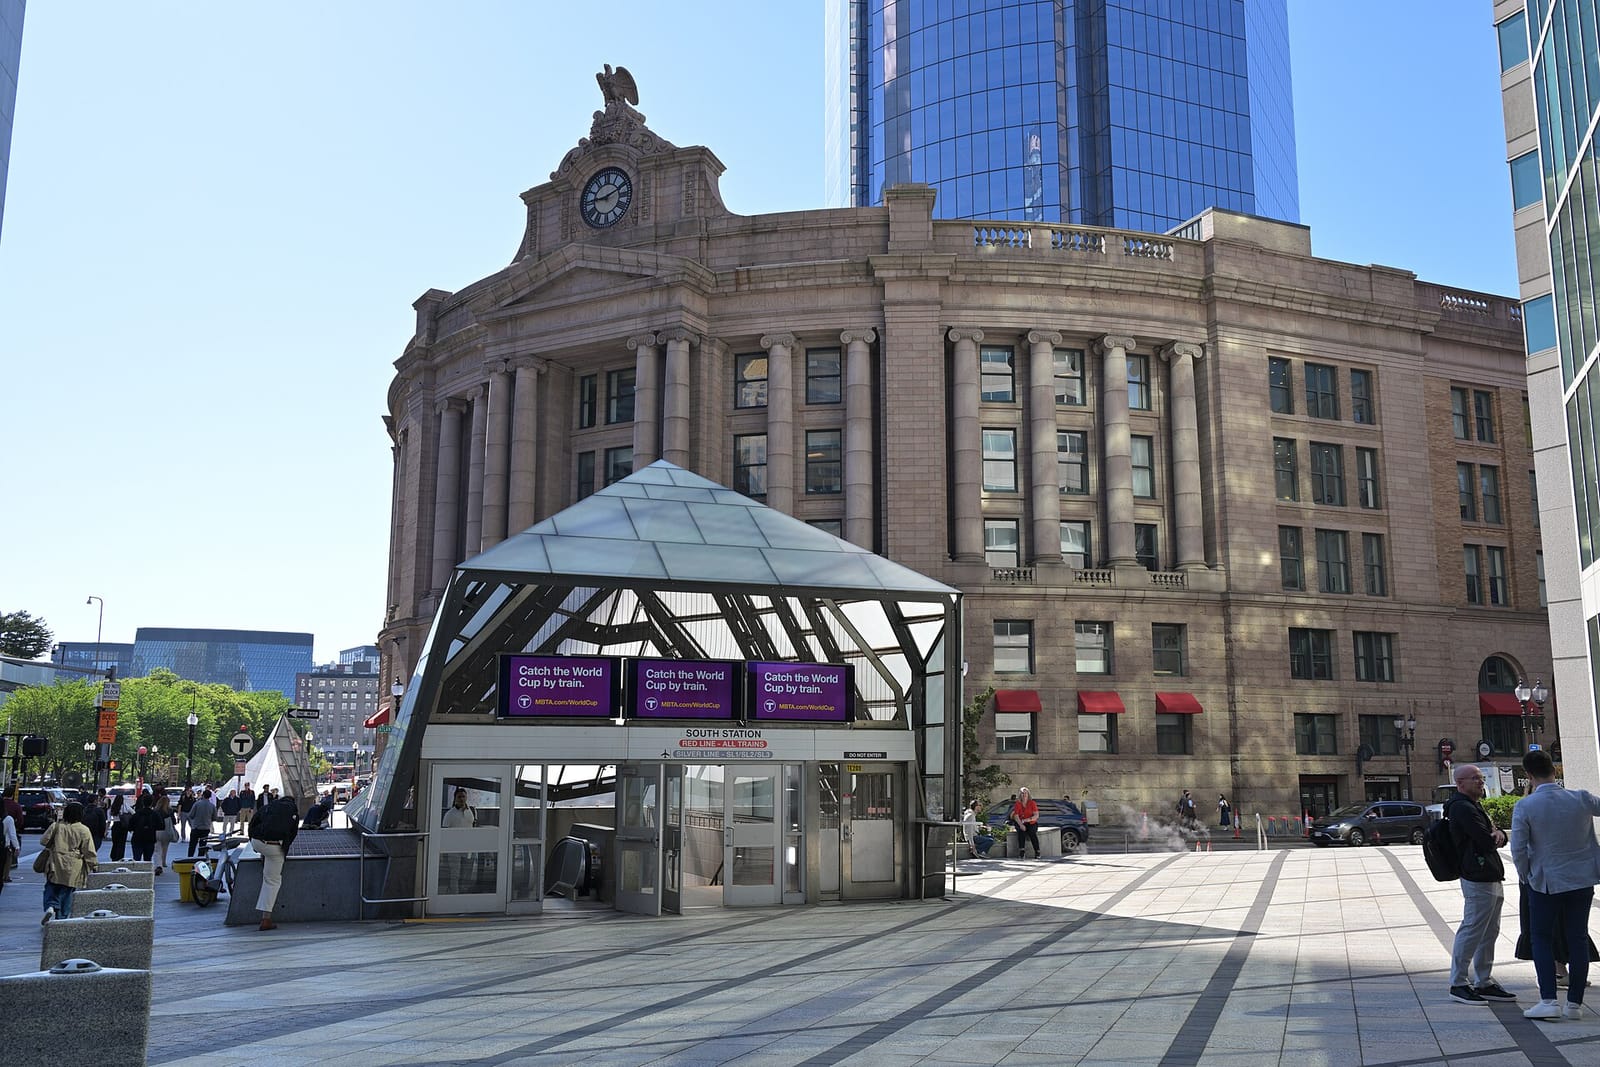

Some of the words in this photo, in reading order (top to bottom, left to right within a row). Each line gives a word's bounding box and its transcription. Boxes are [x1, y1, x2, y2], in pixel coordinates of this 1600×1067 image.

[519, 665, 551, 676] Catch
[553, 666, 570, 676] the
[572, 667, 603, 677] World
[646, 669, 676, 679] Catch
[678, 670, 694, 680] the
[696, 670, 725, 680] World
[518, 677, 541, 689] Cup
[543, 678, 556, 689] by
[558, 678, 585, 688] train.
[764, 672, 793, 682] Catch
[794, 673, 810, 683] the
[811, 674, 839, 684] World
[645, 680, 667, 692] Cup
[668, 681, 681, 692] by
[683, 681, 708, 691] train.
[764, 683, 784, 694] Cup
[786, 684, 798, 695] by
[799, 684, 823, 694] train.
[534, 698, 598, 707] MBTA.com/WorldCup
[661, 701, 721, 709] MBTA.com/WorldCup
[778, 703, 835, 711] MBTA.com/WorldCup
[686, 729, 720, 738] SOUTH
[722, 729, 762, 738] STATION
[234, 738, 251, 753] T
